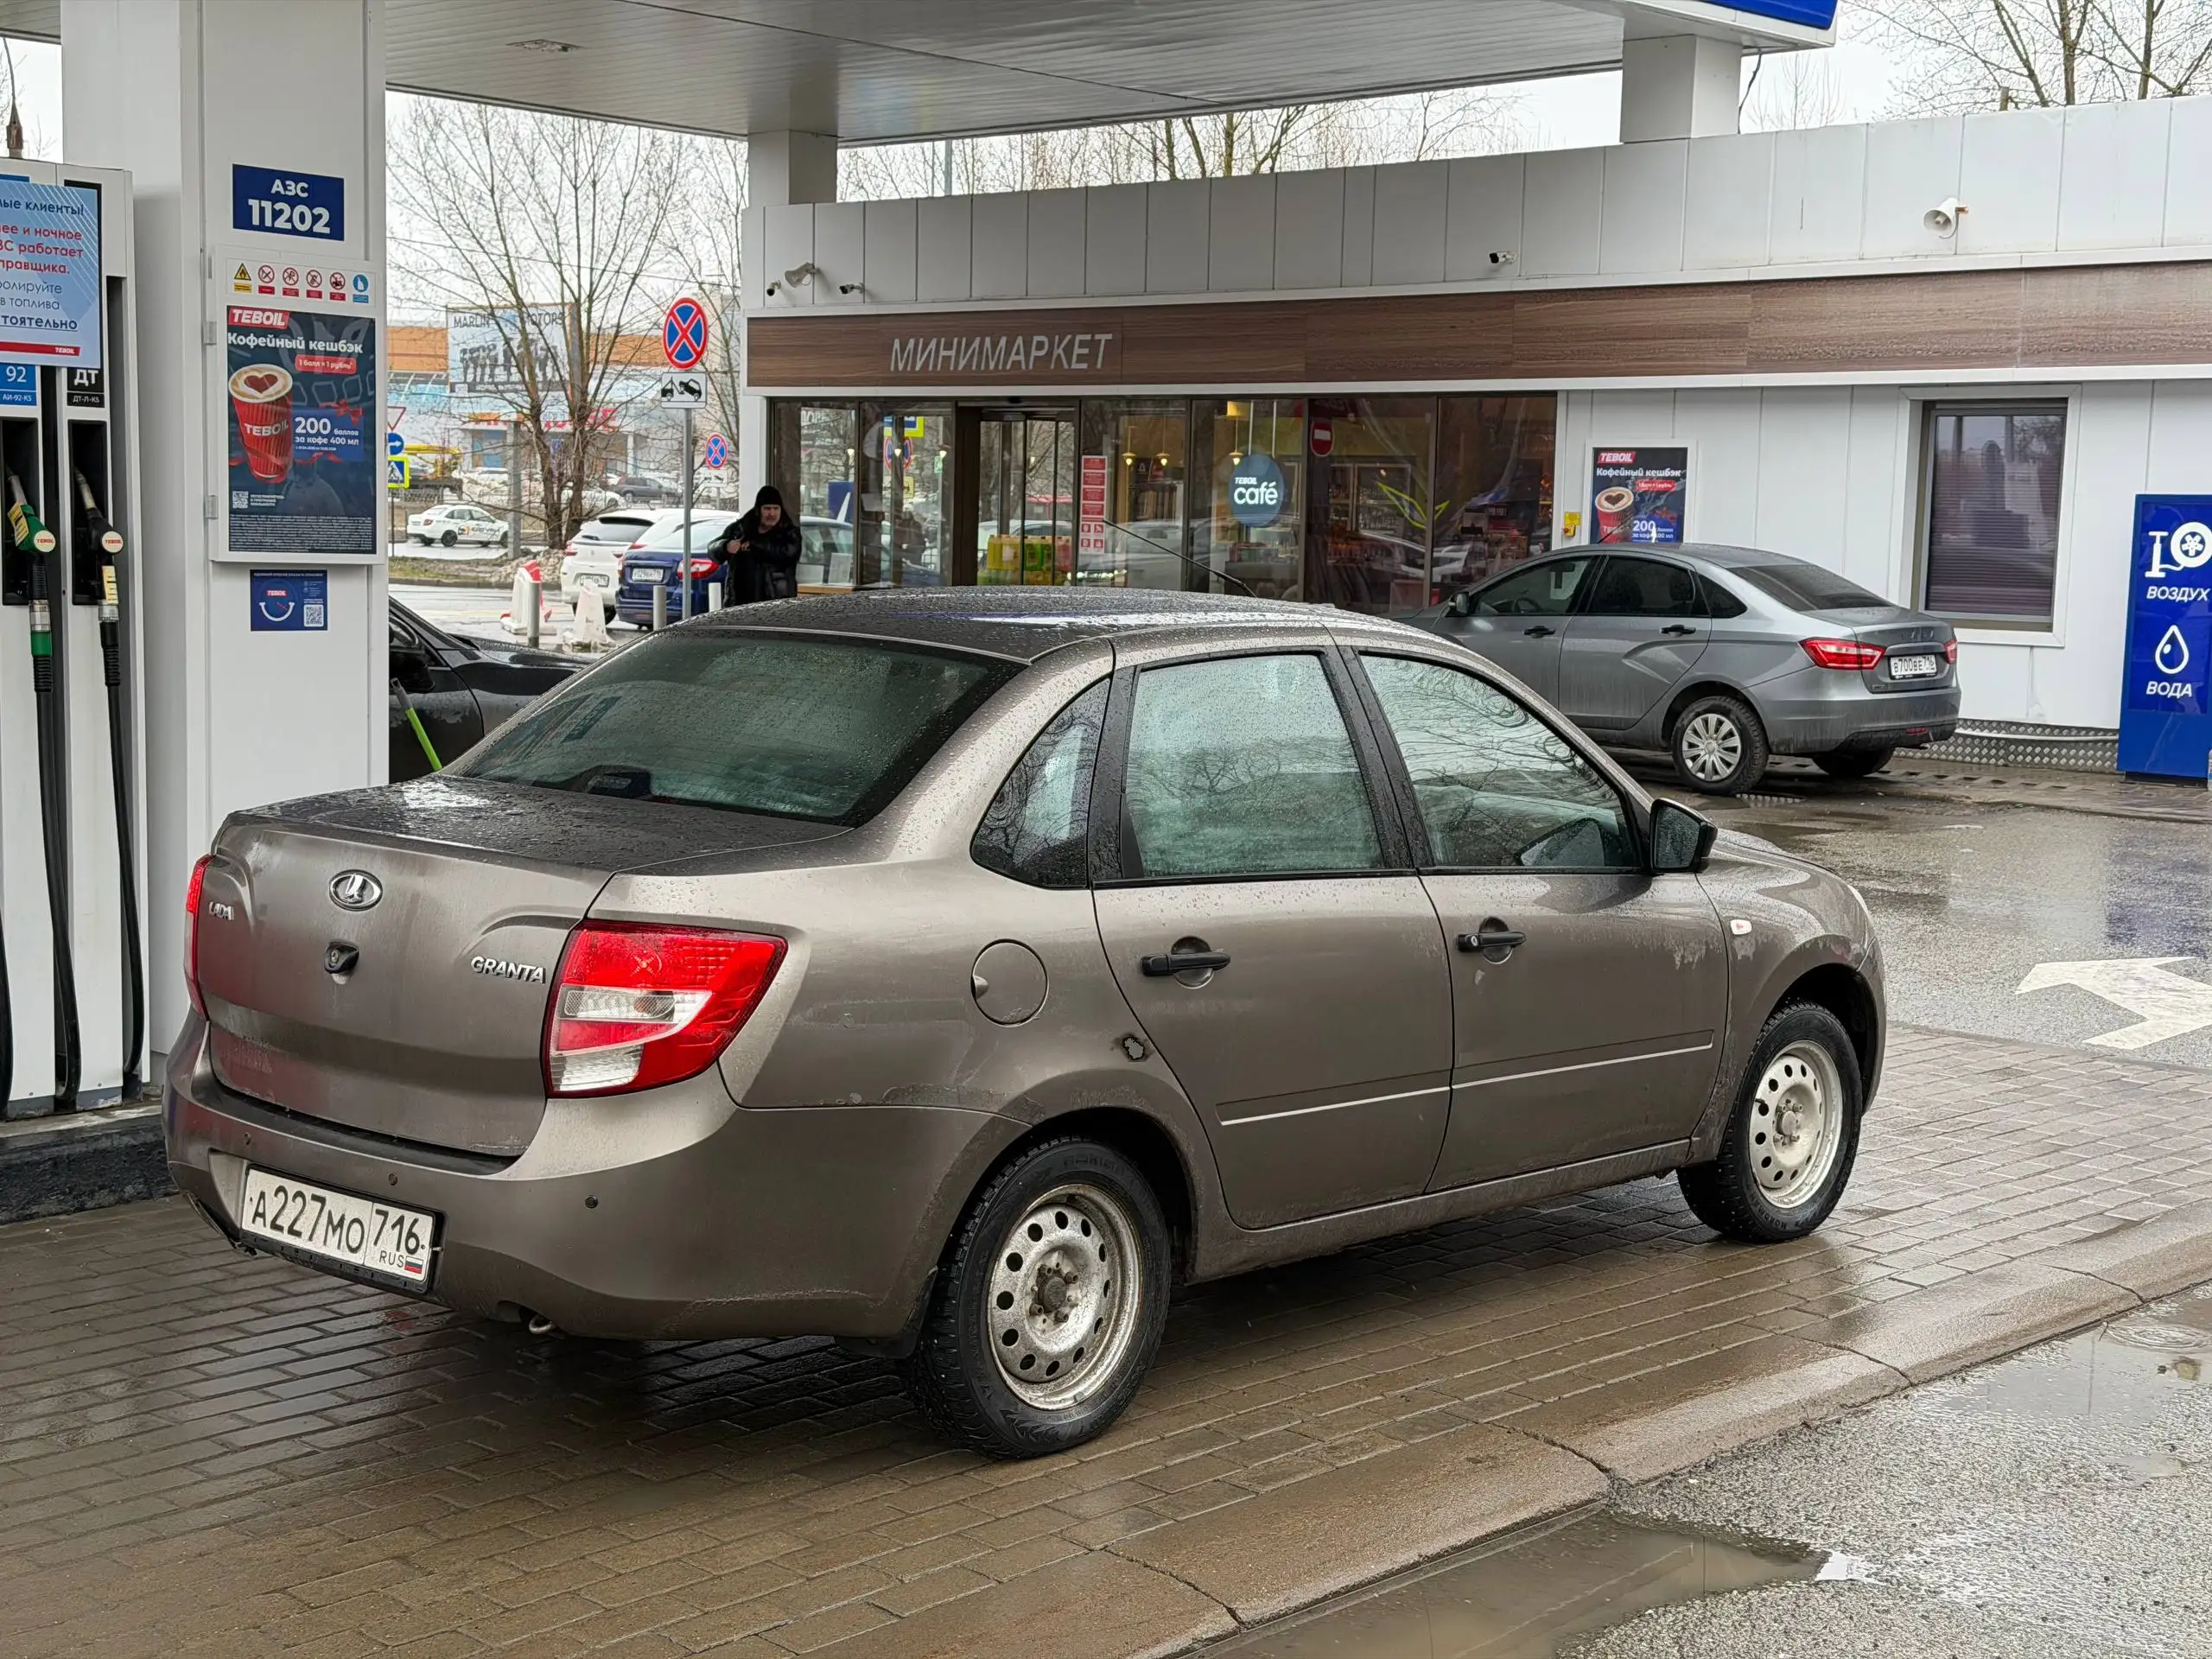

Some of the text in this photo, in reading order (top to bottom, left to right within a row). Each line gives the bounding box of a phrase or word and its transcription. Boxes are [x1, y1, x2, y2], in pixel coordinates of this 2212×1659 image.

[270, 178, 309, 198] АЗС
[25, 200, 84, 215] клиенты!
[247, 198, 331, 234] 11202
[0, 224, 82, 241] ее и ночное
[18, 242, 84, 258] работает
[10, 296, 60, 310] топлива
[232, 308, 286, 327] TEBOIL
[227, 332, 364, 354] Кофейный кешбэк
[890, 333, 1113, 372] МИНИМАРКЕТ
[6, 365, 27, 383] 92
[73, 368, 99, 386] ДТ
[295, 416, 332, 435] 200
[307, 436, 328, 445] кофе
[330, 436, 346, 445] 400
[1599, 452, 1633, 462] TEBOIL
[1596, 467, 1681, 478] Кофейный кешбэк
[1233, 480, 1278, 505] café
[1632, 520, 1656, 532] 200
[2145, 585, 2212, 603] ВОЗДУХ
[2145, 680, 2193, 699] ВОДА
[470, 956, 547, 983] GRANTA
[372, 1208, 421, 1255] 716
[378, 1249, 405, 1268] RUS
